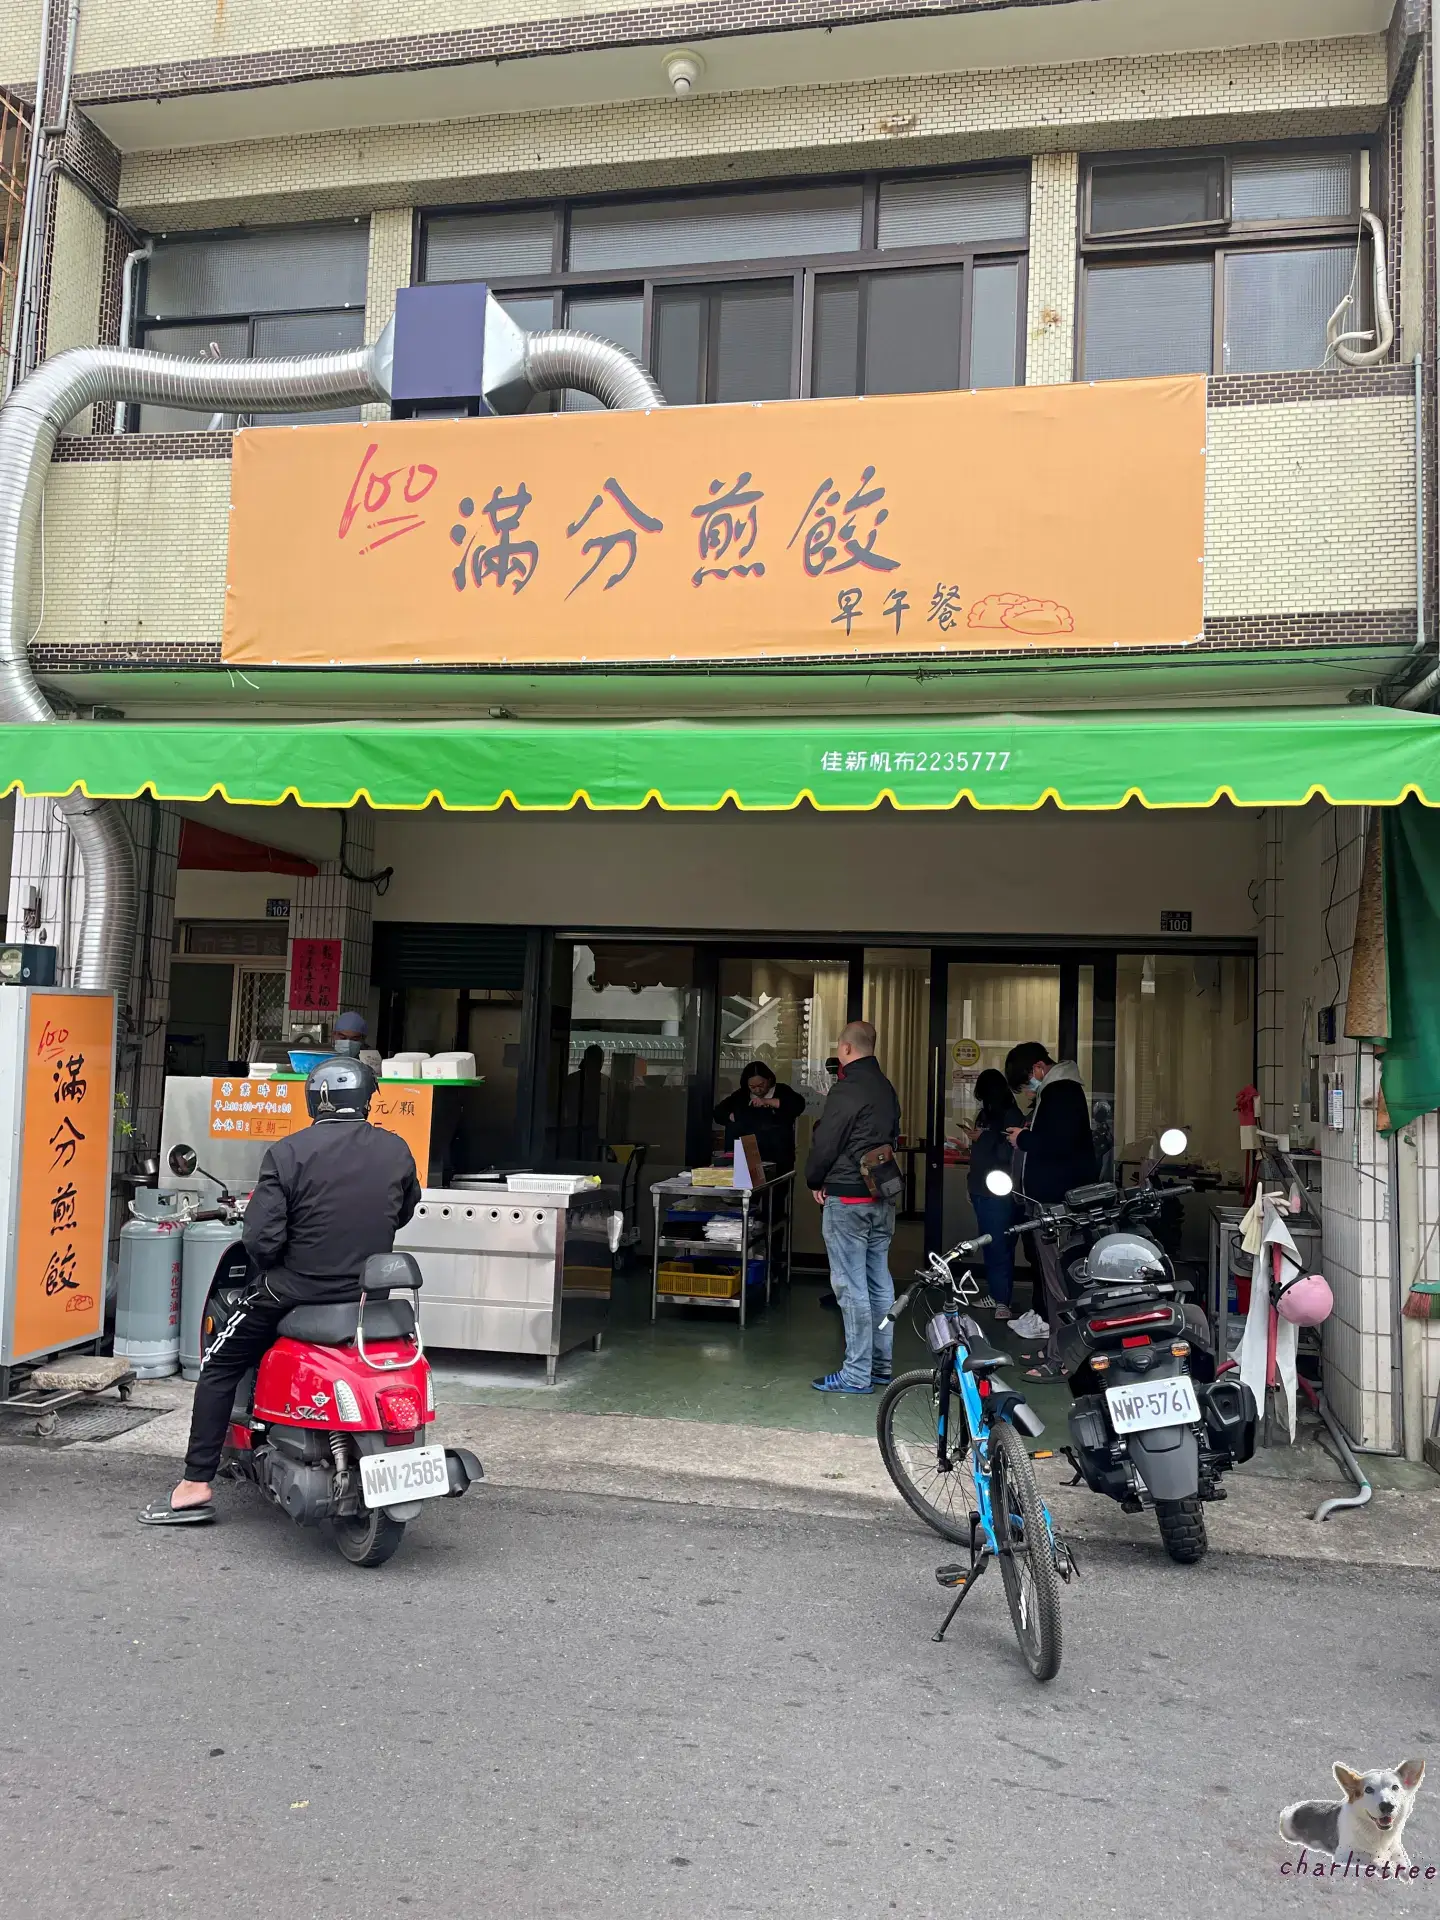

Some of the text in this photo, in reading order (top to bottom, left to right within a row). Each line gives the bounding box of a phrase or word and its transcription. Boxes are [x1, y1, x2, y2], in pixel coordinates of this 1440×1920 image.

[339, 443, 438, 540] 100
[450, 465, 902, 603] 滿分煎餃
[830, 582, 964, 637] 早午餐
[820, 750, 1011, 773] 佳新帆布2235777
[272, 905, 289, 916] 102
[1168, 919, 1189, 931] 100
[37, 1020, 69, 1057] 100
[221, 1081, 288, 1098] 營業時間
[253, 1120, 288, 1135] 星期一
[40, 1053, 87, 1297] 滿分煎餃
